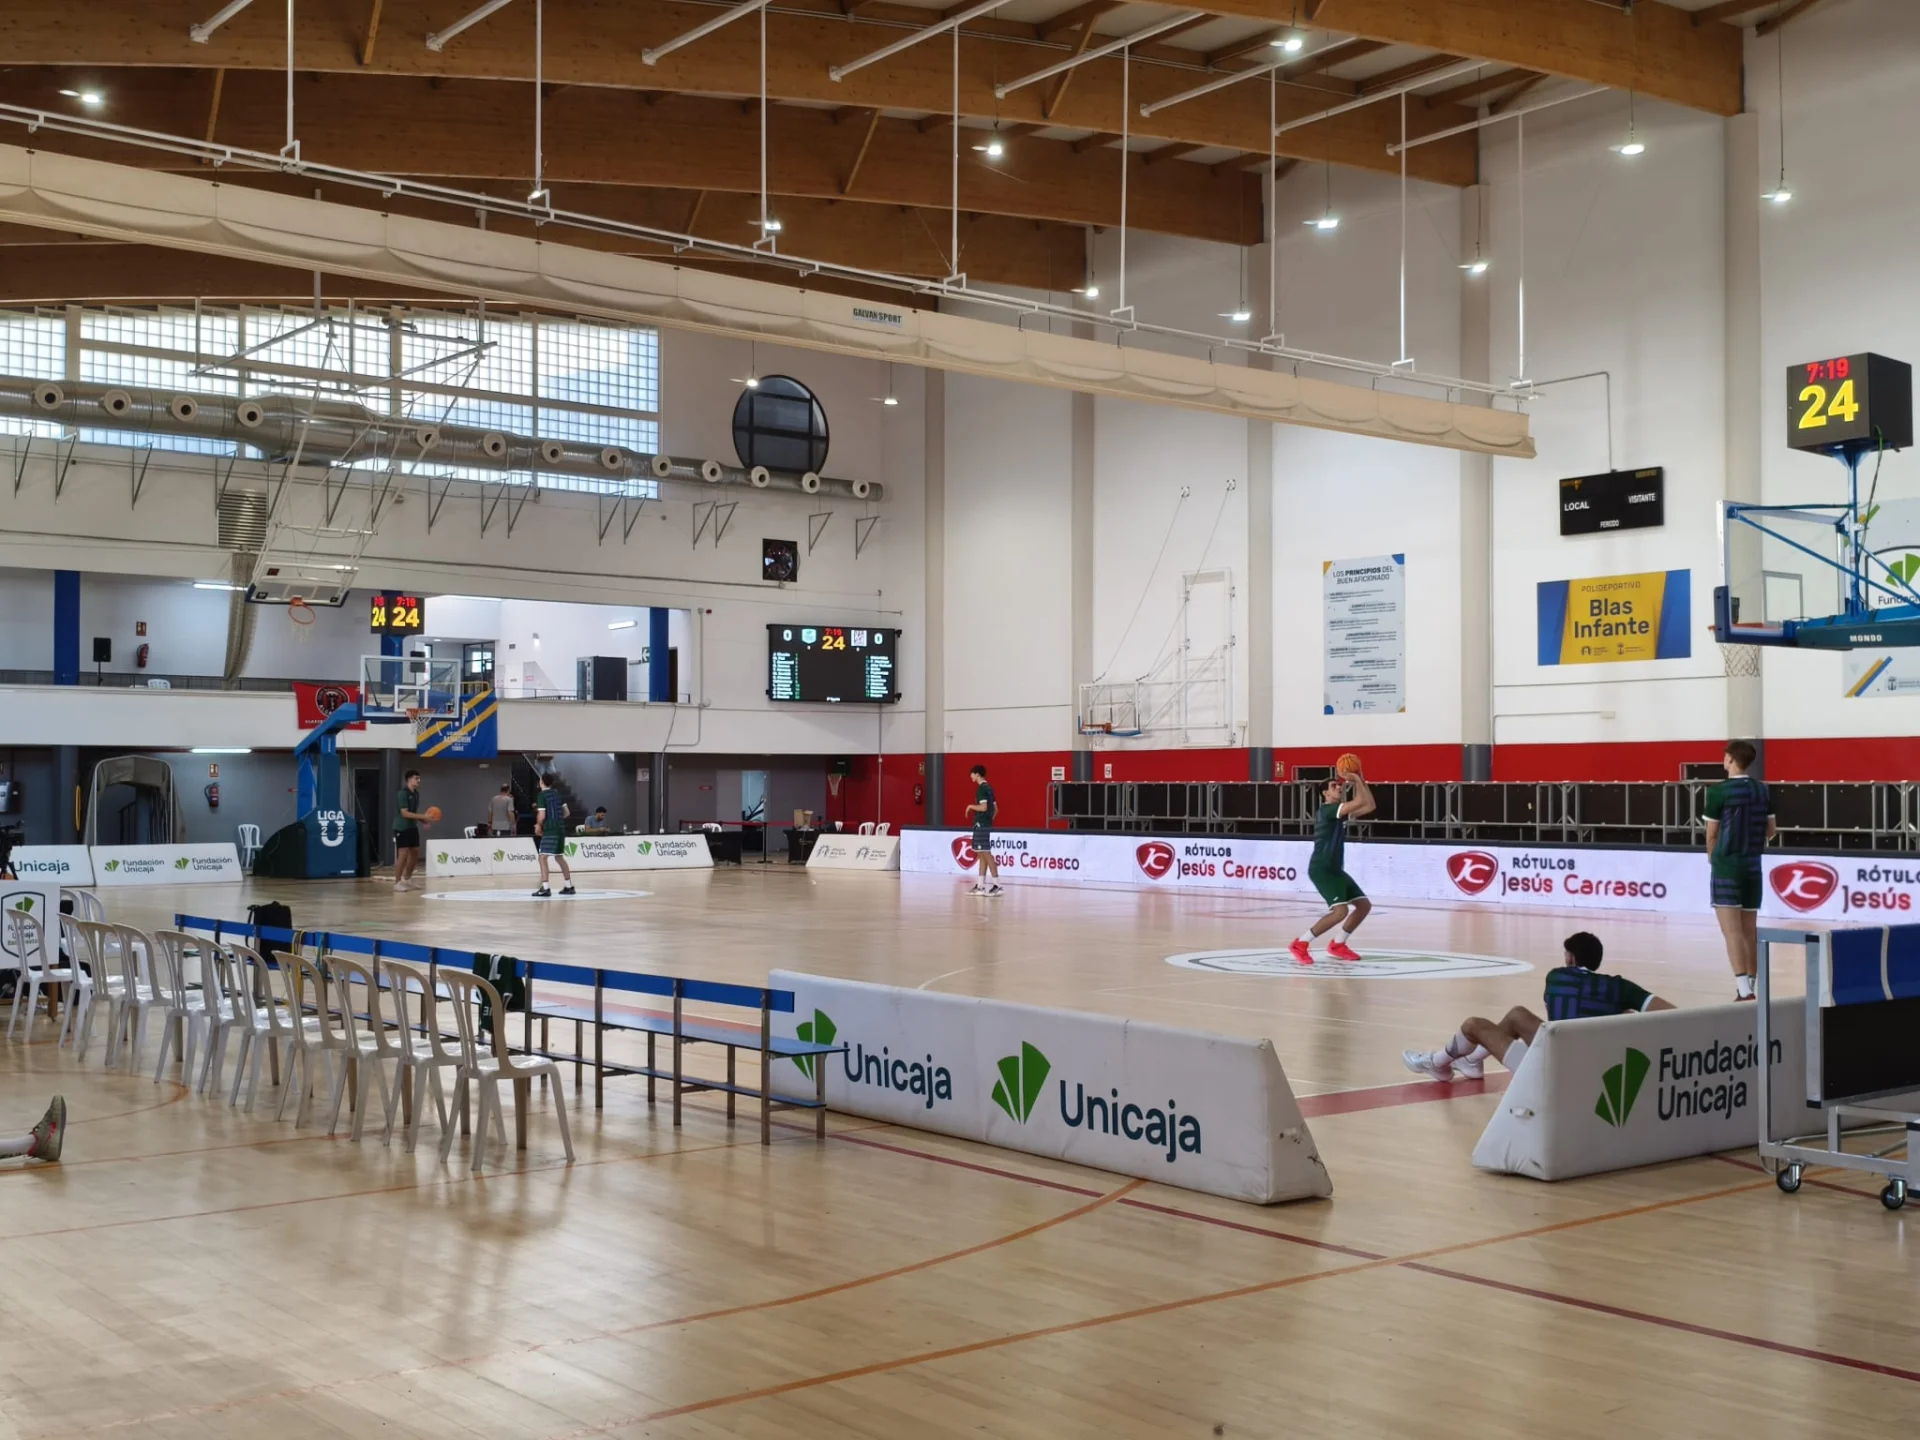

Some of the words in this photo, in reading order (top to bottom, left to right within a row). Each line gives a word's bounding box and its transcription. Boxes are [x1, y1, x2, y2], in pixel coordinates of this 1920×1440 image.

[878, 312, 902, 324] SPORT
[1806, 357, 1849, 384] 7:19
[1799, 380, 1859, 429] 24
[1628, 492, 1656, 504] VISITANTE
[1564, 501, 1590, 511] LOCAL
[1333, 570, 1344, 578] LOS
[1345, 566, 1381, 576] PRINCIPIOS
[1382, 565, 1394, 573] DEL
[1337, 576, 1353, 585] BUEN
[1354, 573, 1390, 583] AFICIONADO
[1581, 581, 1641, 592] POLIDEPORTIVO
[1590, 598, 1633, 617] Blas
[372, 607, 386, 627] 24
[392, 607, 420, 627] 24
[1574, 617, 1650, 639] Infante
[783, 629, 792, 641] 0
[874, 633, 883, 644] 0
[1850, 633, 1882, 642] MONDO
[822, 636, 846, 650] 24
[317, 810, 345, 820] LIGA
[580, 841, 625, 851] Fundación
[654, 840, 697, 848] Fundación
[1185, 843, 1232, 857] RÓTULOS
[507, 852, 536, 862] Unicaja
[583, 850, 615, 859] Unicaja
[656, 848, 688, 857] Unicaja
[13, 859, 70, 874] Unicaja
[122, 859, 165, 867] Fundación
[451, 855, 482, 865] Unicaja
[993, 852, 1015, 867] sús
[1020, 852, 1080, 870] Carrasco
[1512, 854, 1575, 870] RÓTULOS
[124, 866, 155, 874] Unicaja
[1177, 858, 1215, 879] Jesús
[1223, 860, 1297, 881] Carrasco
[1501, 871, 1553, 896] Jesús
[1563, 874, 1667, 899] Carrasco
[1842, 885, 1911, 913] Jesús
[843, 1041, 952, 1109] Unicaja
[1658, 1074, 1747, 1121] Unicaja
[1060, 1079, 1201, 1162] Unicaja
